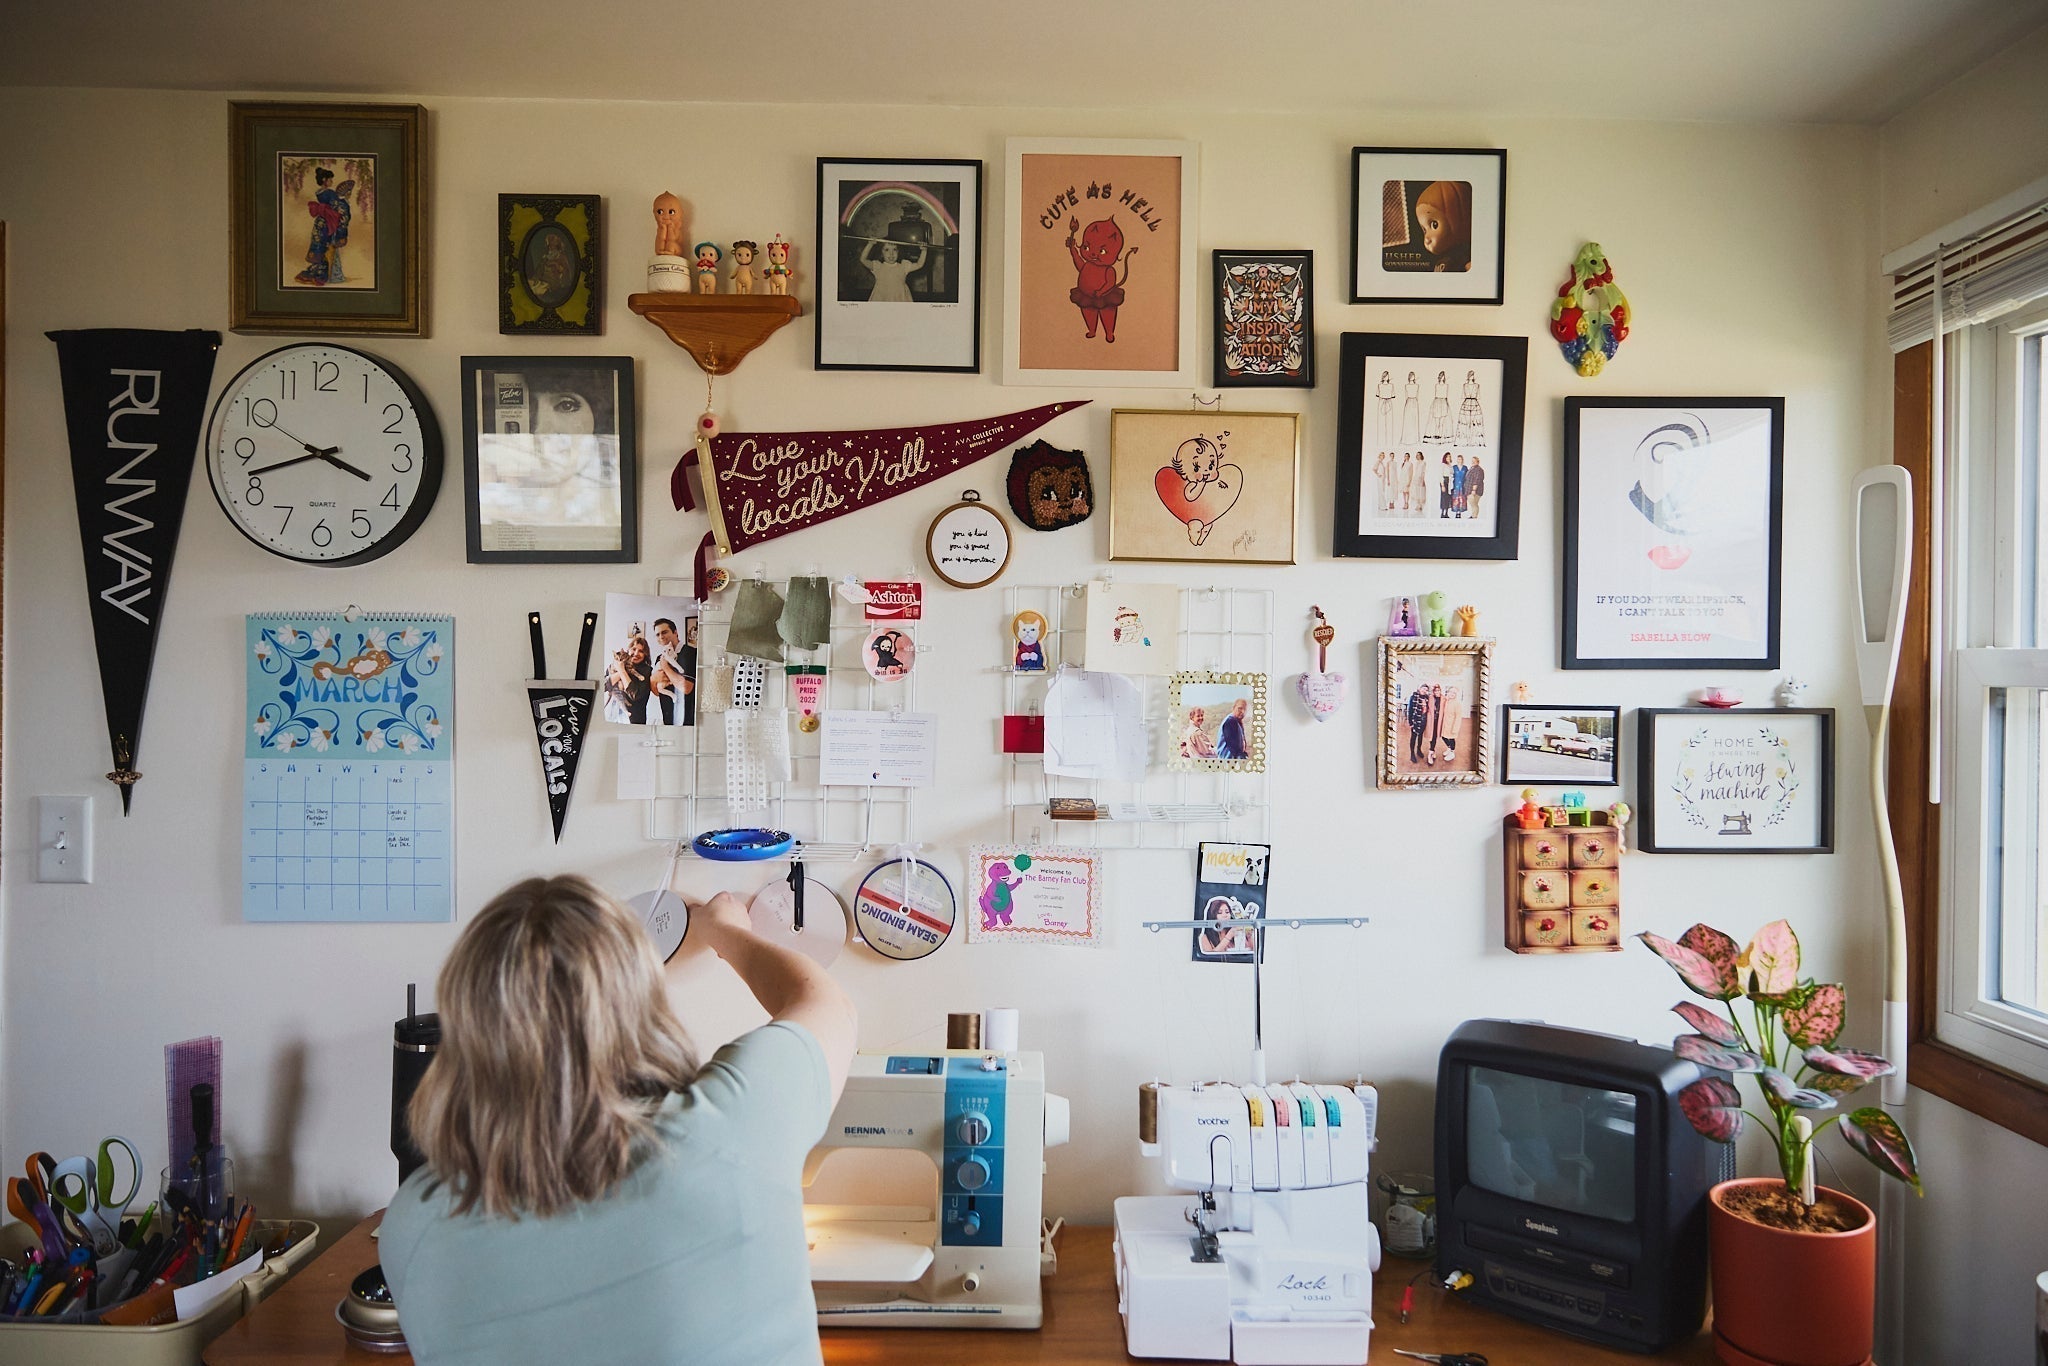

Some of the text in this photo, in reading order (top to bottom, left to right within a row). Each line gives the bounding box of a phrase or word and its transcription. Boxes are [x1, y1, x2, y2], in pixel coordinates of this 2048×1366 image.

[1040, 180, 1162, 232] CUTE AS HELL
[1260, 280, 1280, 291] AM
[1254, 302, 1274, 313] MY
[1240, 322, 1288, 334] INSPIR
[280, 370, 296, 400] 11
[313, 361, 339, 391] 12
[363, 374, 368, 403] 1
[245, 398, 277, 427] 10
[382, 404, 403, 433] 2
[973, 425, 1004, 440] COLLECTIVE
[235, 437, 255, 466] 9
[392, 444, 412, 473] 3
[720, 439, 804, 482] Love
[778, 448, 843, 498] your
[845, 437, 930, 500] Y'all
[101, 368, 161, 625] RUNWAY
[246, 477, 264, 506] 8
[380, 483, 400, 511] 4
[742, 476, 844, 534] locals
[274, 506, 293, 535] 7
[312, 518, 332, 547] 6
[351, 510, 371, 538] 5
[952, 531, 965, 540] you
[871, 590, 916, 604] Ashton
[294, 676, 403, 703] MARCH
[532, 695, 568, 795] LOCALS
[563, 733, 573, 753] YOUR
[1714, 738, 1754, 747] HOME
[260, 764, 432, 774] S M T W T F S
[1700, 781, 1770, 800] machine
[1038, 875, 1059, 884] Barney
[861, 903, 938, 944] SEAM BINDING
[1044, 919, 1068, 928] Barney
[1198, 1118, 1230, 1126] brother
[1525, 1218, 1558, 1235] Symphonic
[1277, 1274, 1326, 1290] Lock
